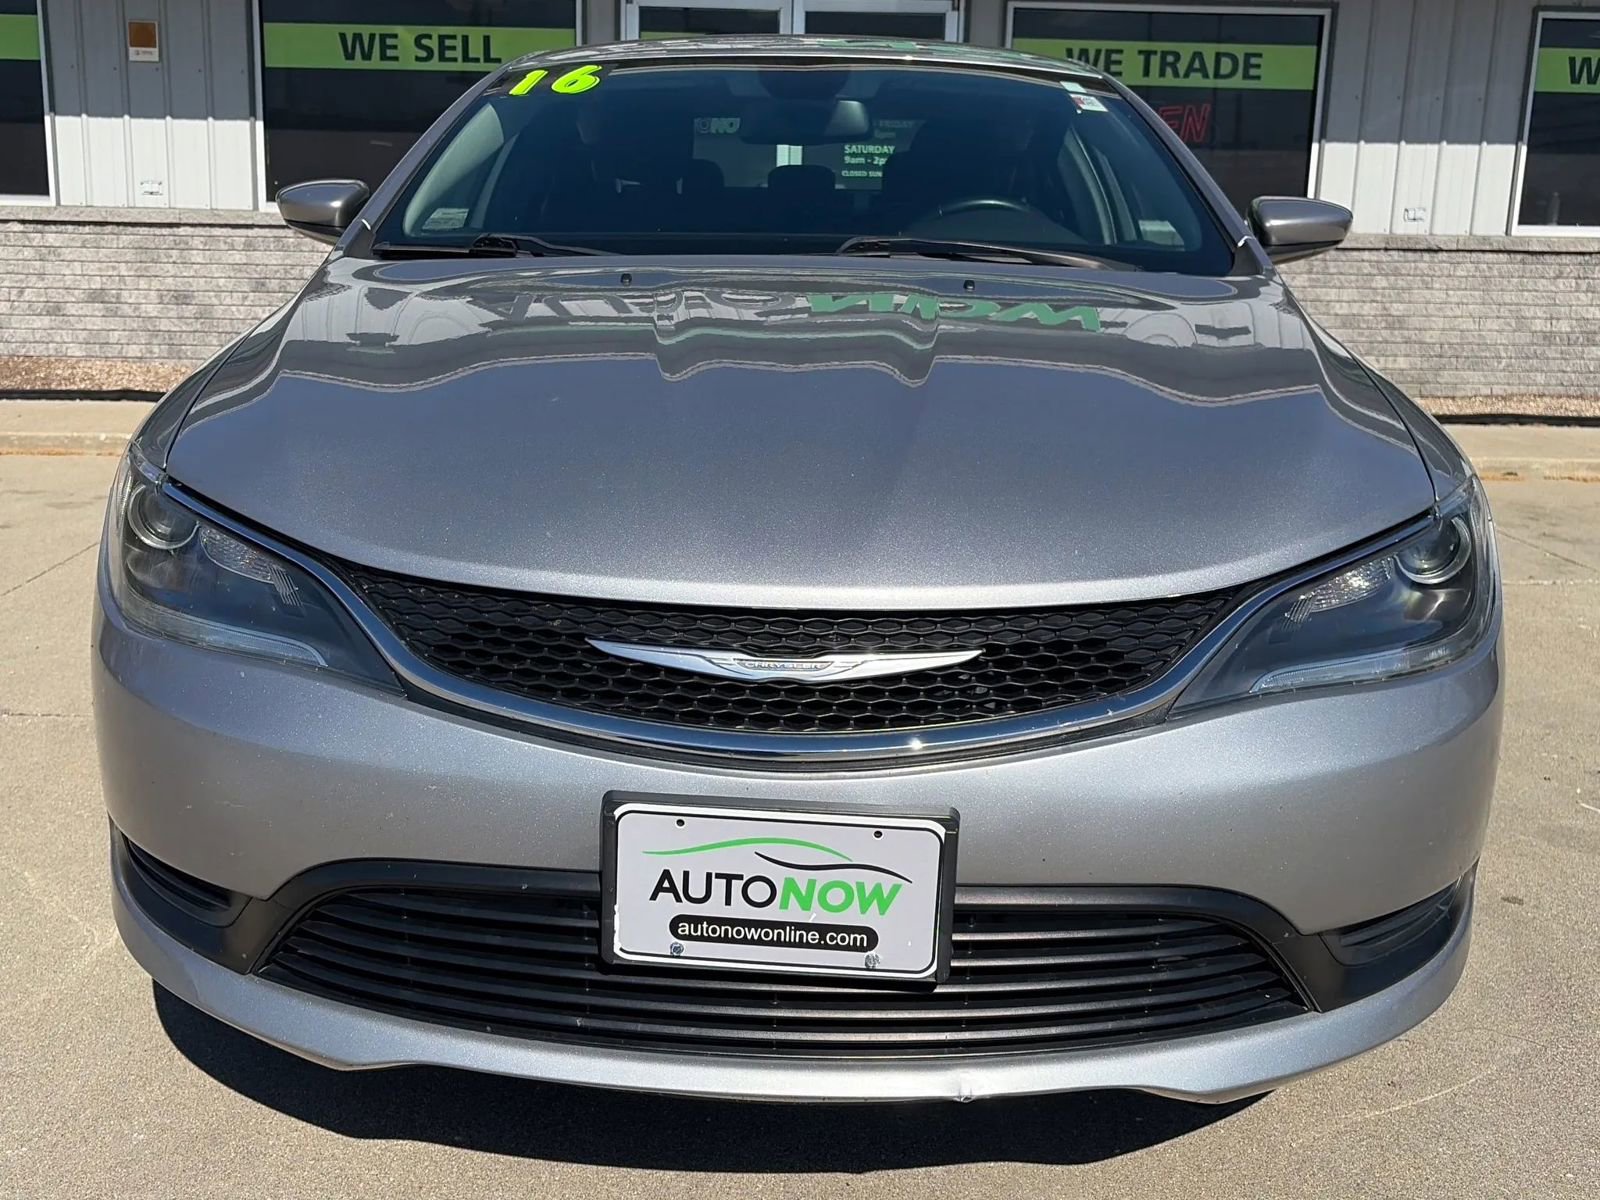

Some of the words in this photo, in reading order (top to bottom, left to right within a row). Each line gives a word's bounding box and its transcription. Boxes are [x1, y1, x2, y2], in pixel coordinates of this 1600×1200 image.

[338, 32, 399, 62] WE
[413, 33, 502, 64] SELL
[1065, 47, 1124, 77] WE
[1137, 49, 1263, 81] TRADE
[1568, 56, 1600, 85] W
[508, 64, 602, 96] 16
[1157, 102, 1212, 143] EN
[843, 155, 866, 165] 9am
[873, 156, 888, 167] 2p
[844, 144, 896, 155] SATURDAY
[868, 170, 883, 178] SUN
[677, 920, 868, 948] autonowonline.com
